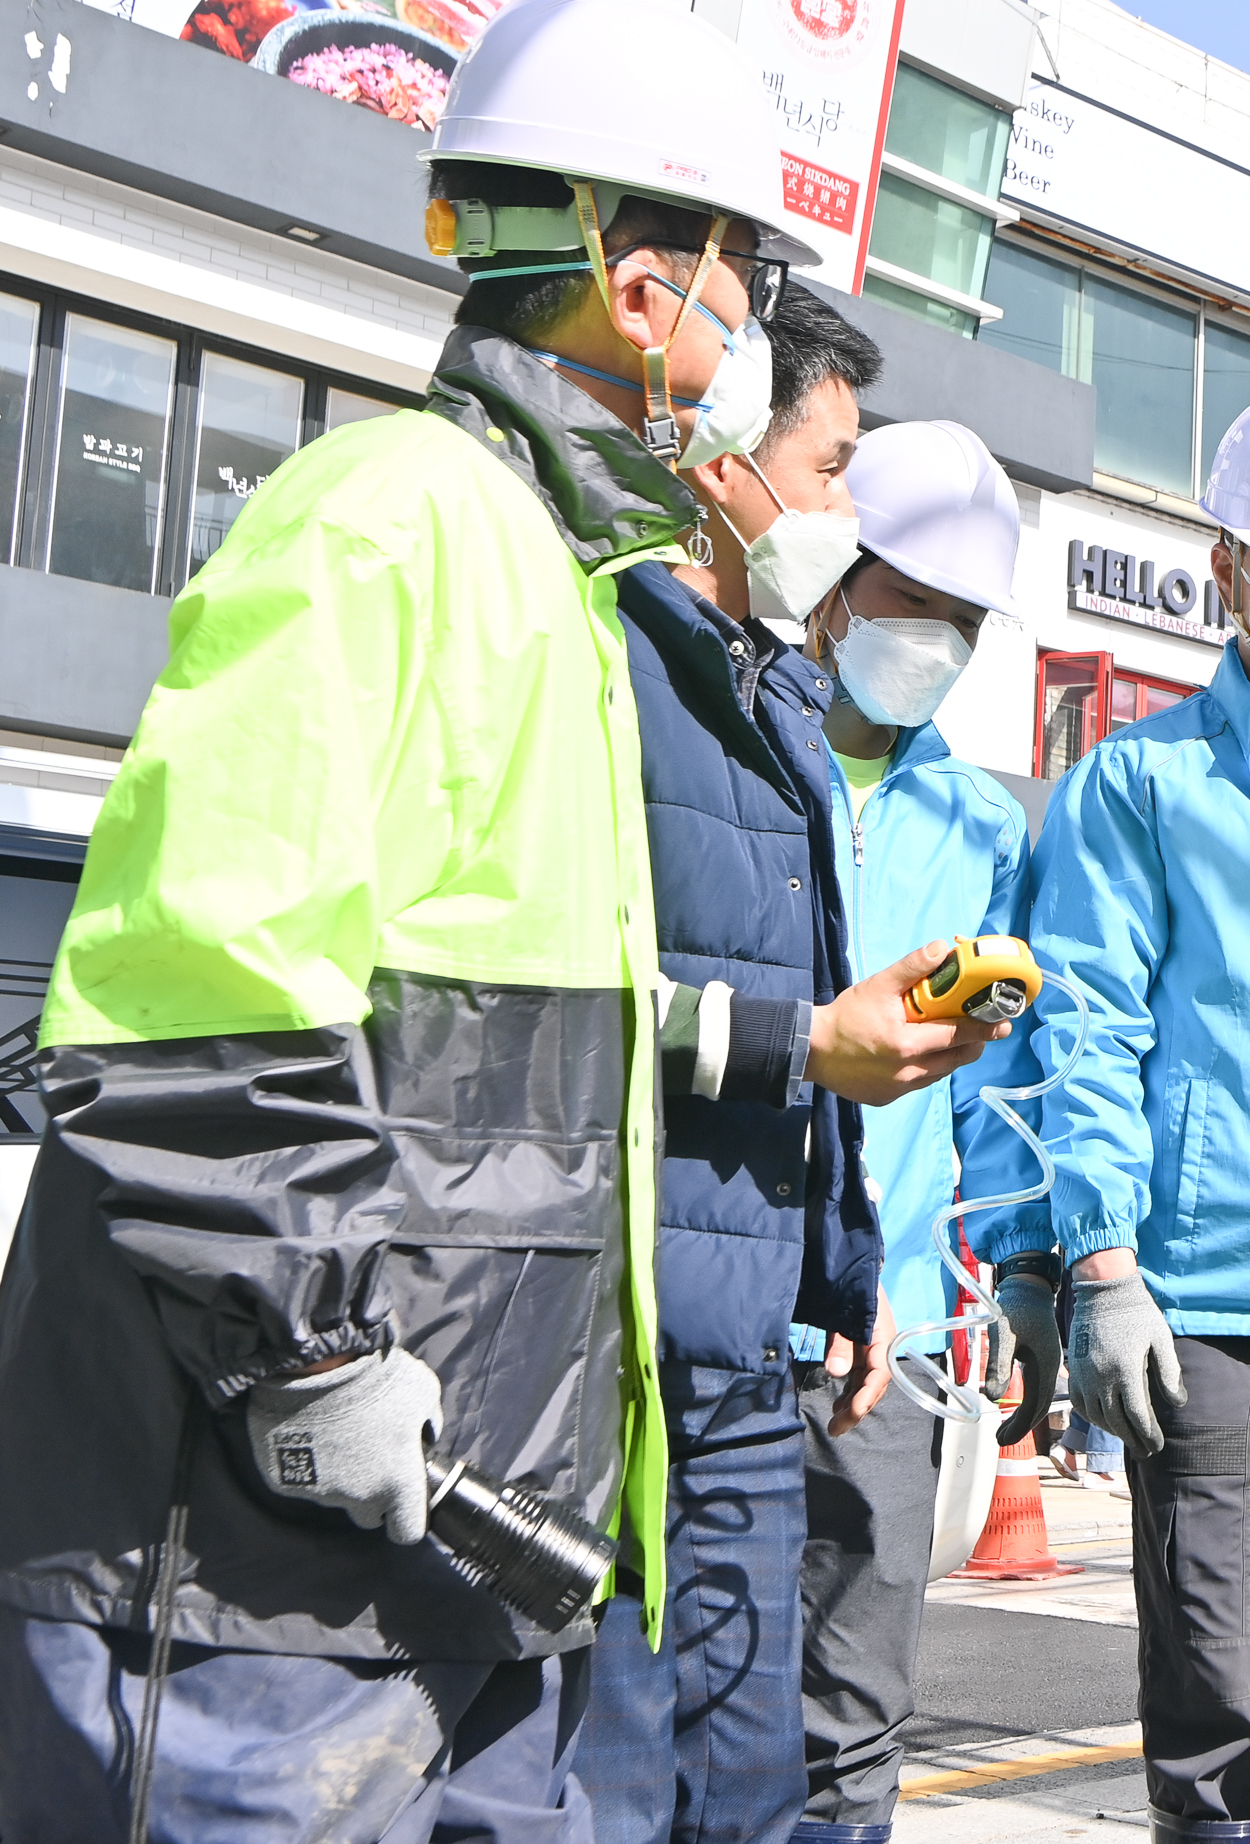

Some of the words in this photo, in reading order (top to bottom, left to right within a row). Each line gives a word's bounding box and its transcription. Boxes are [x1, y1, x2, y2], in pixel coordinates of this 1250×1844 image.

[763, 70, 845, 148] 백년식당
[1024, 98, 1075, 134] skey
[781, 156, 804, 177] EON
[804, 166, 851, 196] SIKDANG
[1004, 159, 1051, 194] Beer
[1068, 539, 1197, 615] HELLO
[1085, 595, 1130, 619] INDIAN
[1144, 611, 1205, 639] LEBANESE
